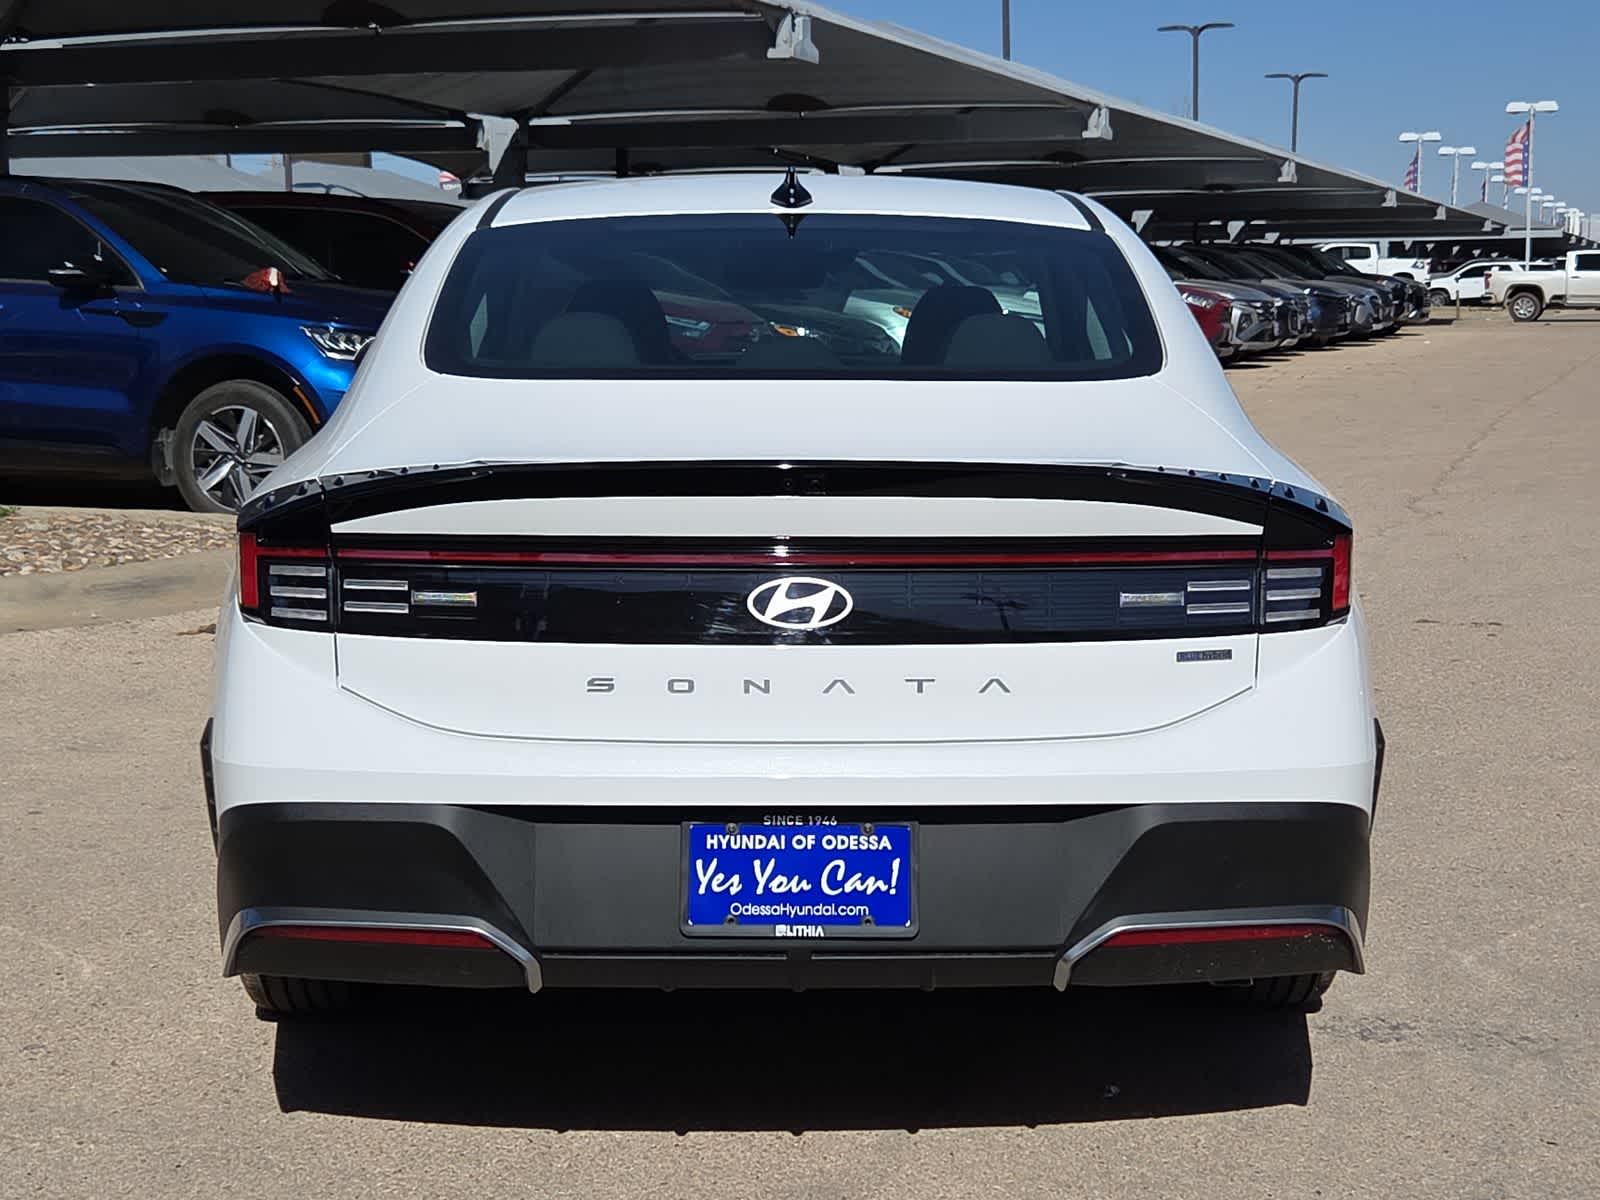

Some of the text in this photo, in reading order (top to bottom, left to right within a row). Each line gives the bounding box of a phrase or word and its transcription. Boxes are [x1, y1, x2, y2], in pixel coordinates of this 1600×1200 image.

[586, 676, 1012, 695] SONATA
[763, 815, 838, 826] SINCE 1946
[706, 834, 892, 850] HYUNDAI OF ODESSA
[695, 858, 901, 895] Yes You Can!
[730, 902, 869, 918] OdessaHyundai.com
